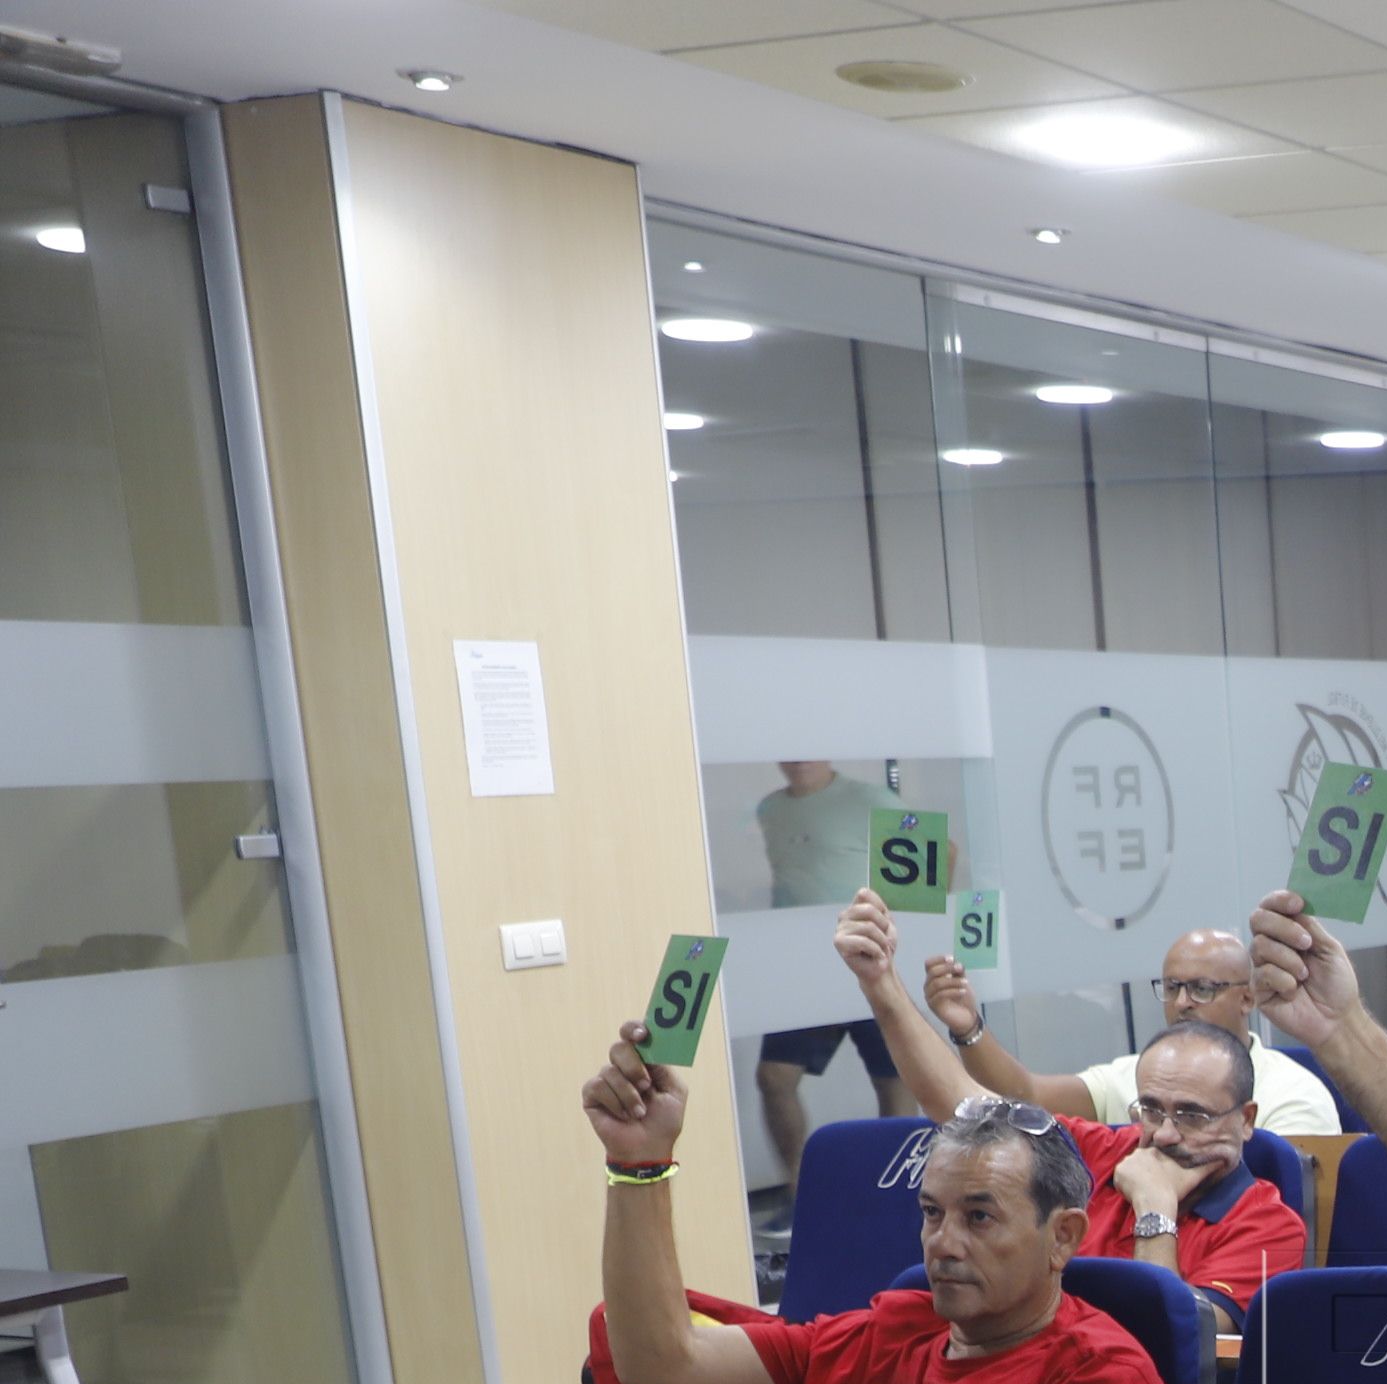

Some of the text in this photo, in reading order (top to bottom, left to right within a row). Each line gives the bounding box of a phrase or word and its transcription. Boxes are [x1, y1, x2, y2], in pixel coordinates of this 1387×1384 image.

[880, 837, 938, 886] SI
[1308, 806, 1385, 880] SI
[960, 912, 993, 949] SI
[654, 970, 710, 1030] SI
